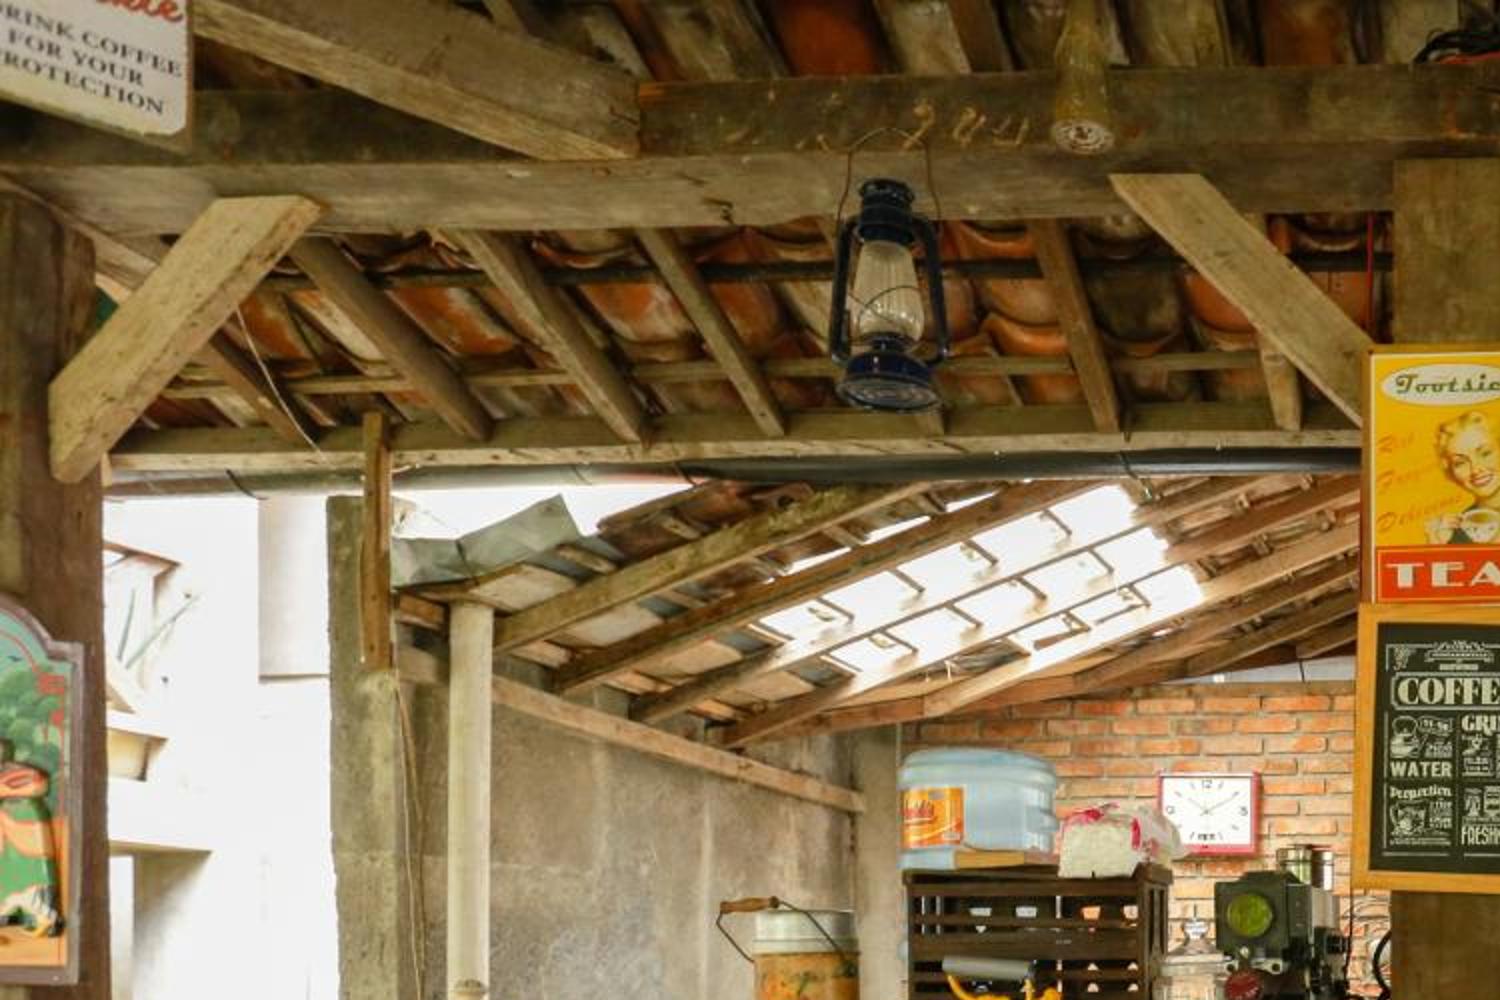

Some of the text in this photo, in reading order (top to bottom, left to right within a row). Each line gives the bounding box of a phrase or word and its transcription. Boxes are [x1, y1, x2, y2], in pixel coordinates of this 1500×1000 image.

[0, 3, 76, 40] RINK
[82, 31, 182, 78] COFFEE
[8, 29, 143, 86] FOR YOUR
[0, 51, 163, 114] ROTECTION
[1390, 761, 1453, 778] WATER
